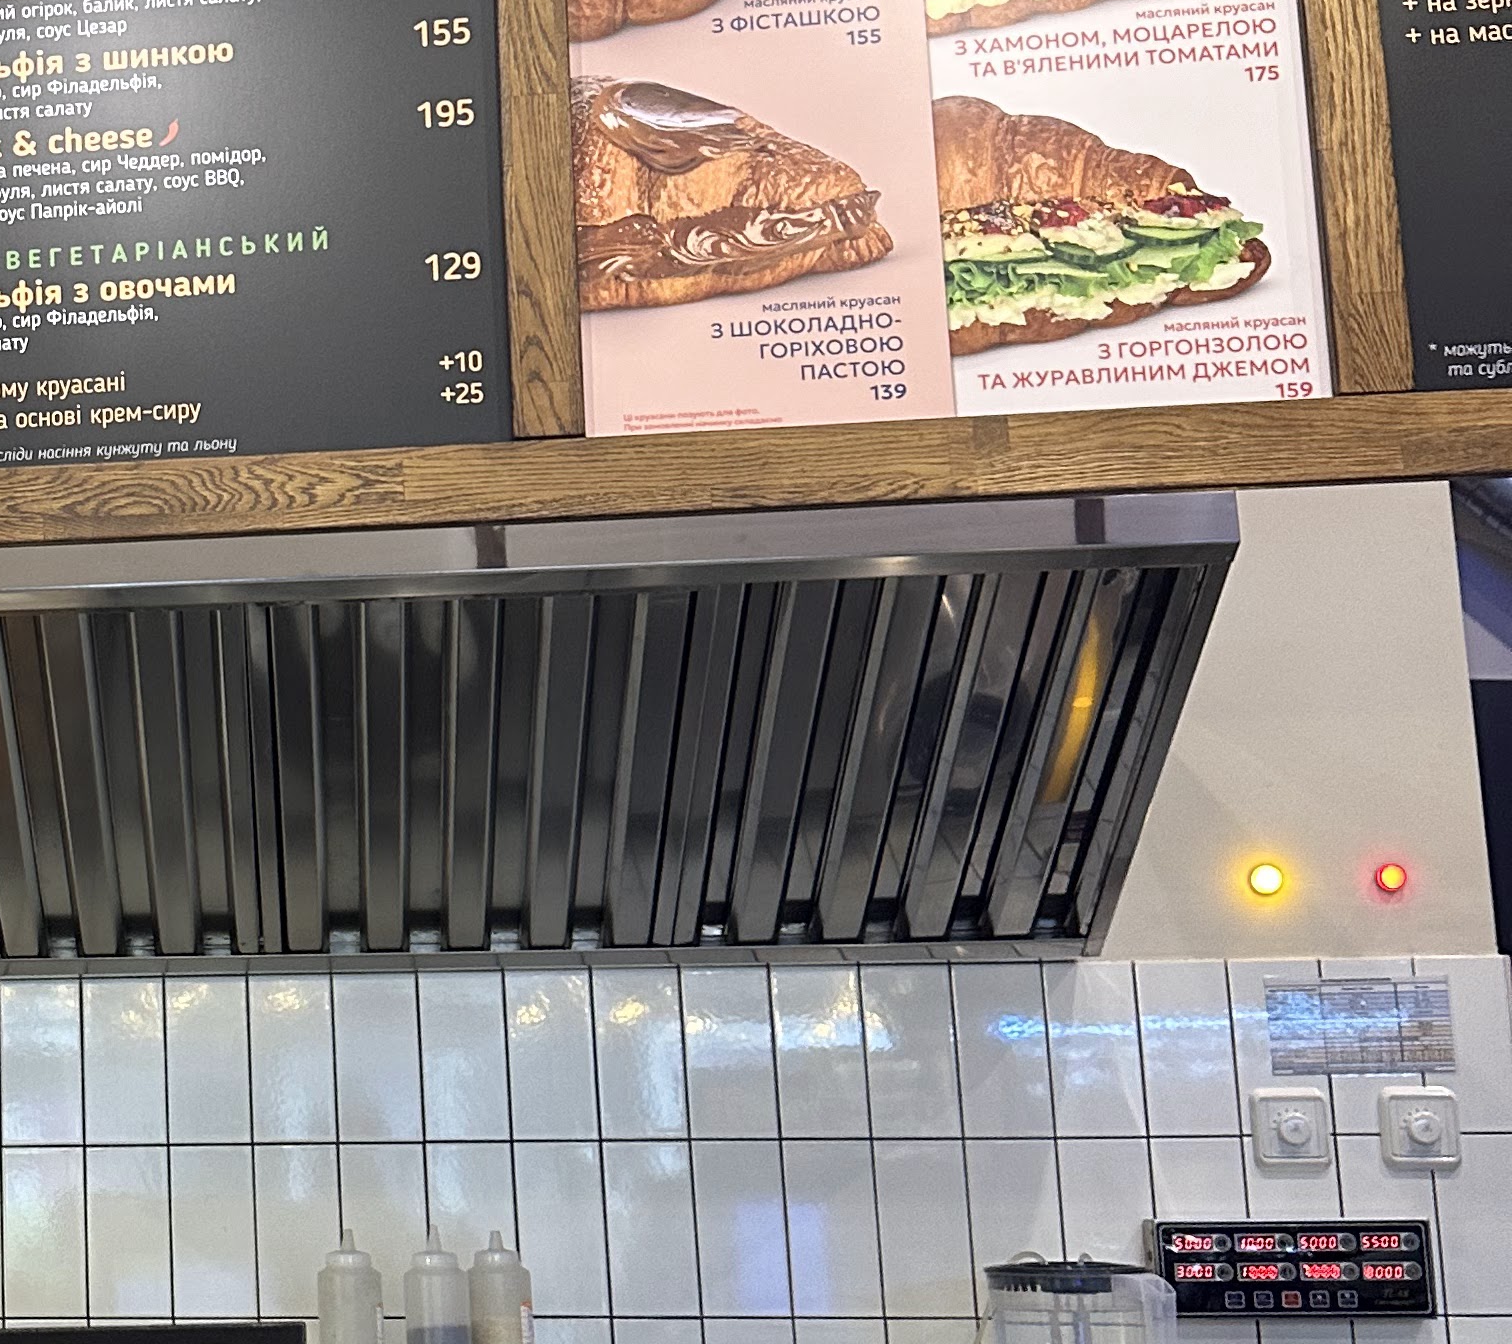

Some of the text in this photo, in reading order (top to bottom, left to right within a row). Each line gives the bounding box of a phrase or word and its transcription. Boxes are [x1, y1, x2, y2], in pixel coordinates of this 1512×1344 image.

[711, 5, 880, 34] З ФІСТАШКОЮ
[846, 28, 882, 46] 155
[954, 17, 1277, 56] З ХАМОНОМ, МОЦАРЕЛОЮ
[968, 61, 998, 78] ТА
[1144, 40, 1279, 66] ТОМАТАМИ
[1244, 65, 1280, 83] 175
[417, 99, 474, 128] 195
[12, 129, 38, 157] &
[48, 127, 152, 155] cheese
[30, 196, 143, 221] Папрік-айолі
[7, 226, 327, 270] ВЕГЕТАРІАНСЬКИЙ
[710, 312, 902, 339] З ШОКОЛАДНО-
[759, 335, 904, 360] ГОРІХОВОЮ
[800, 359, 906, 381] ПАСТОЮ
[869, 383, 907, 401] 139
